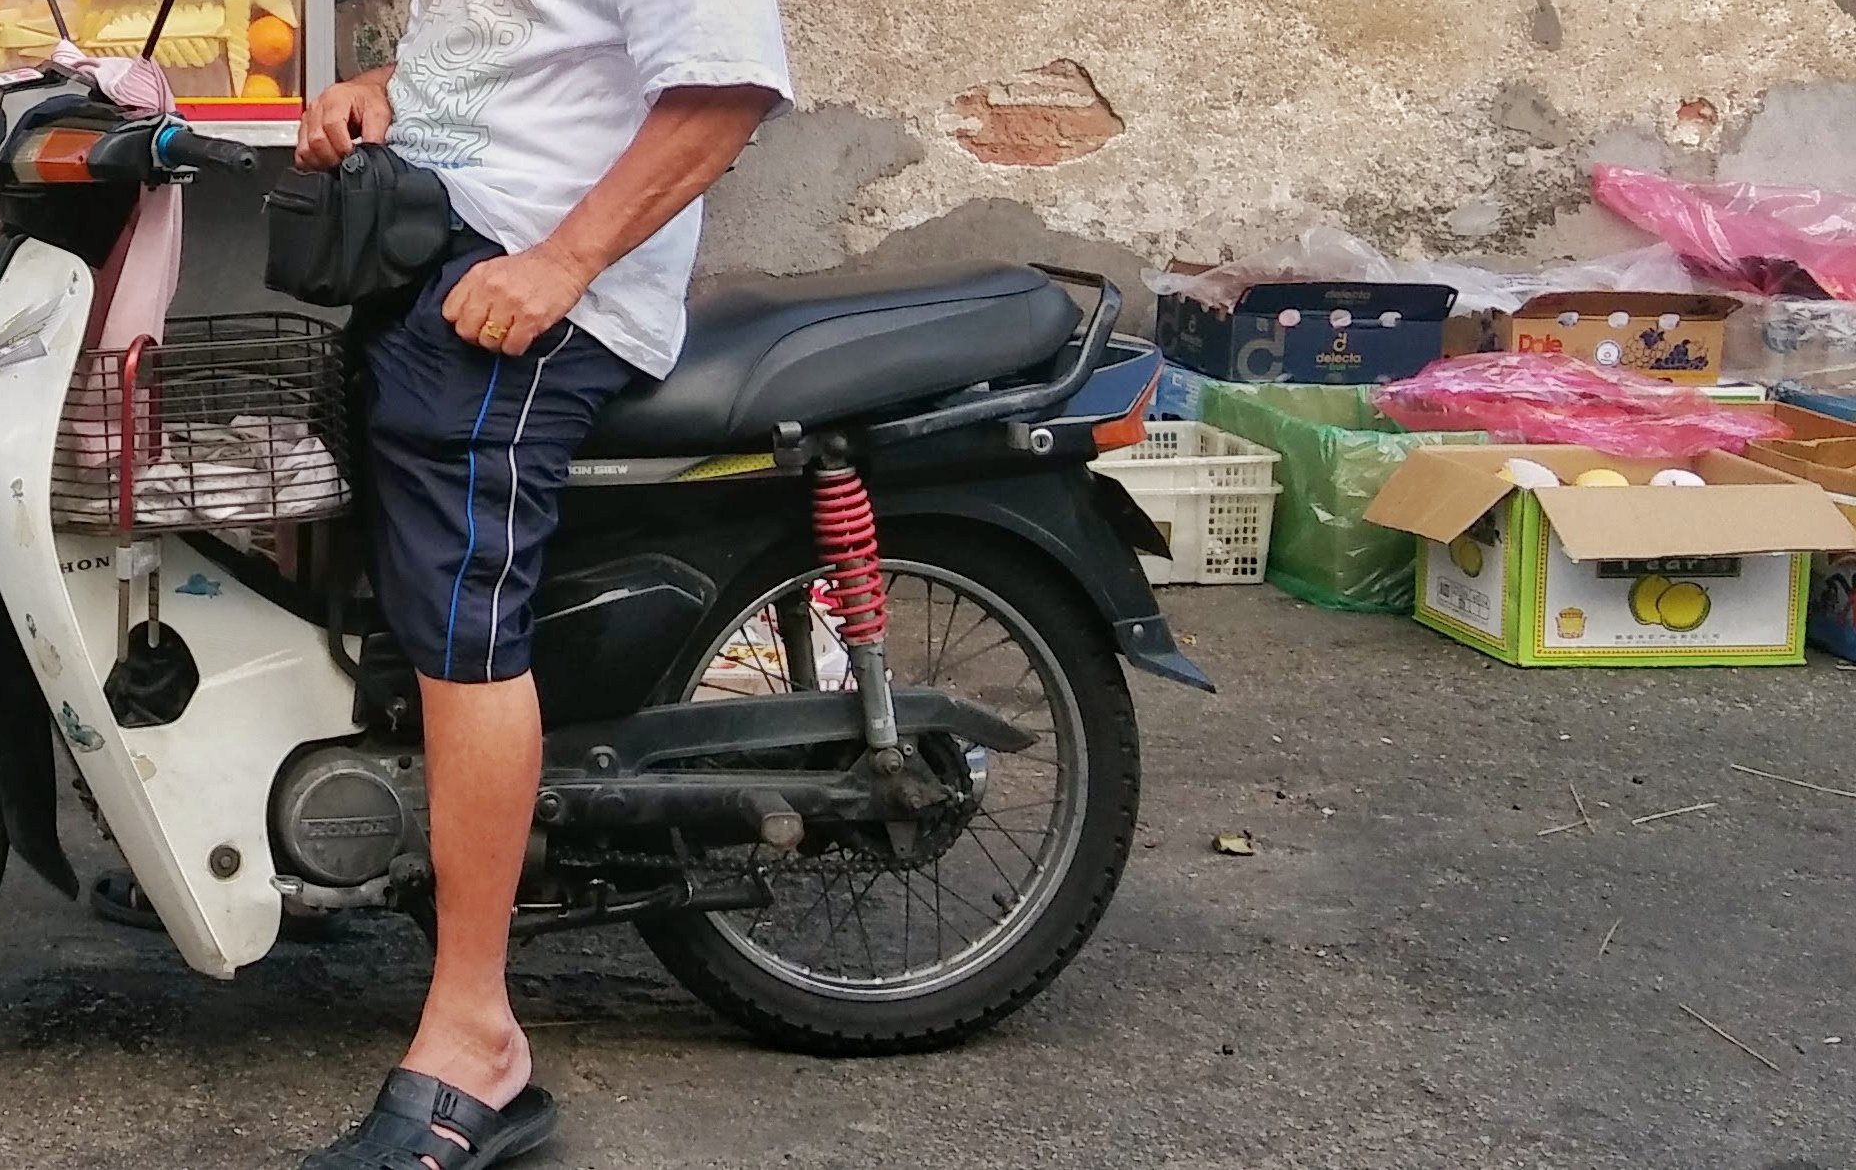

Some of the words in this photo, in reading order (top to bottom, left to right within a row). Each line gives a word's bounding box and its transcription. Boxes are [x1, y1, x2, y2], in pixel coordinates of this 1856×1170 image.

[1519, 334, 1563, 354] Dole
[1315, 352, 1362, 364] delecta
[59, 556, 110, 574] HON
[307, 821, 390, 837] HONDA
